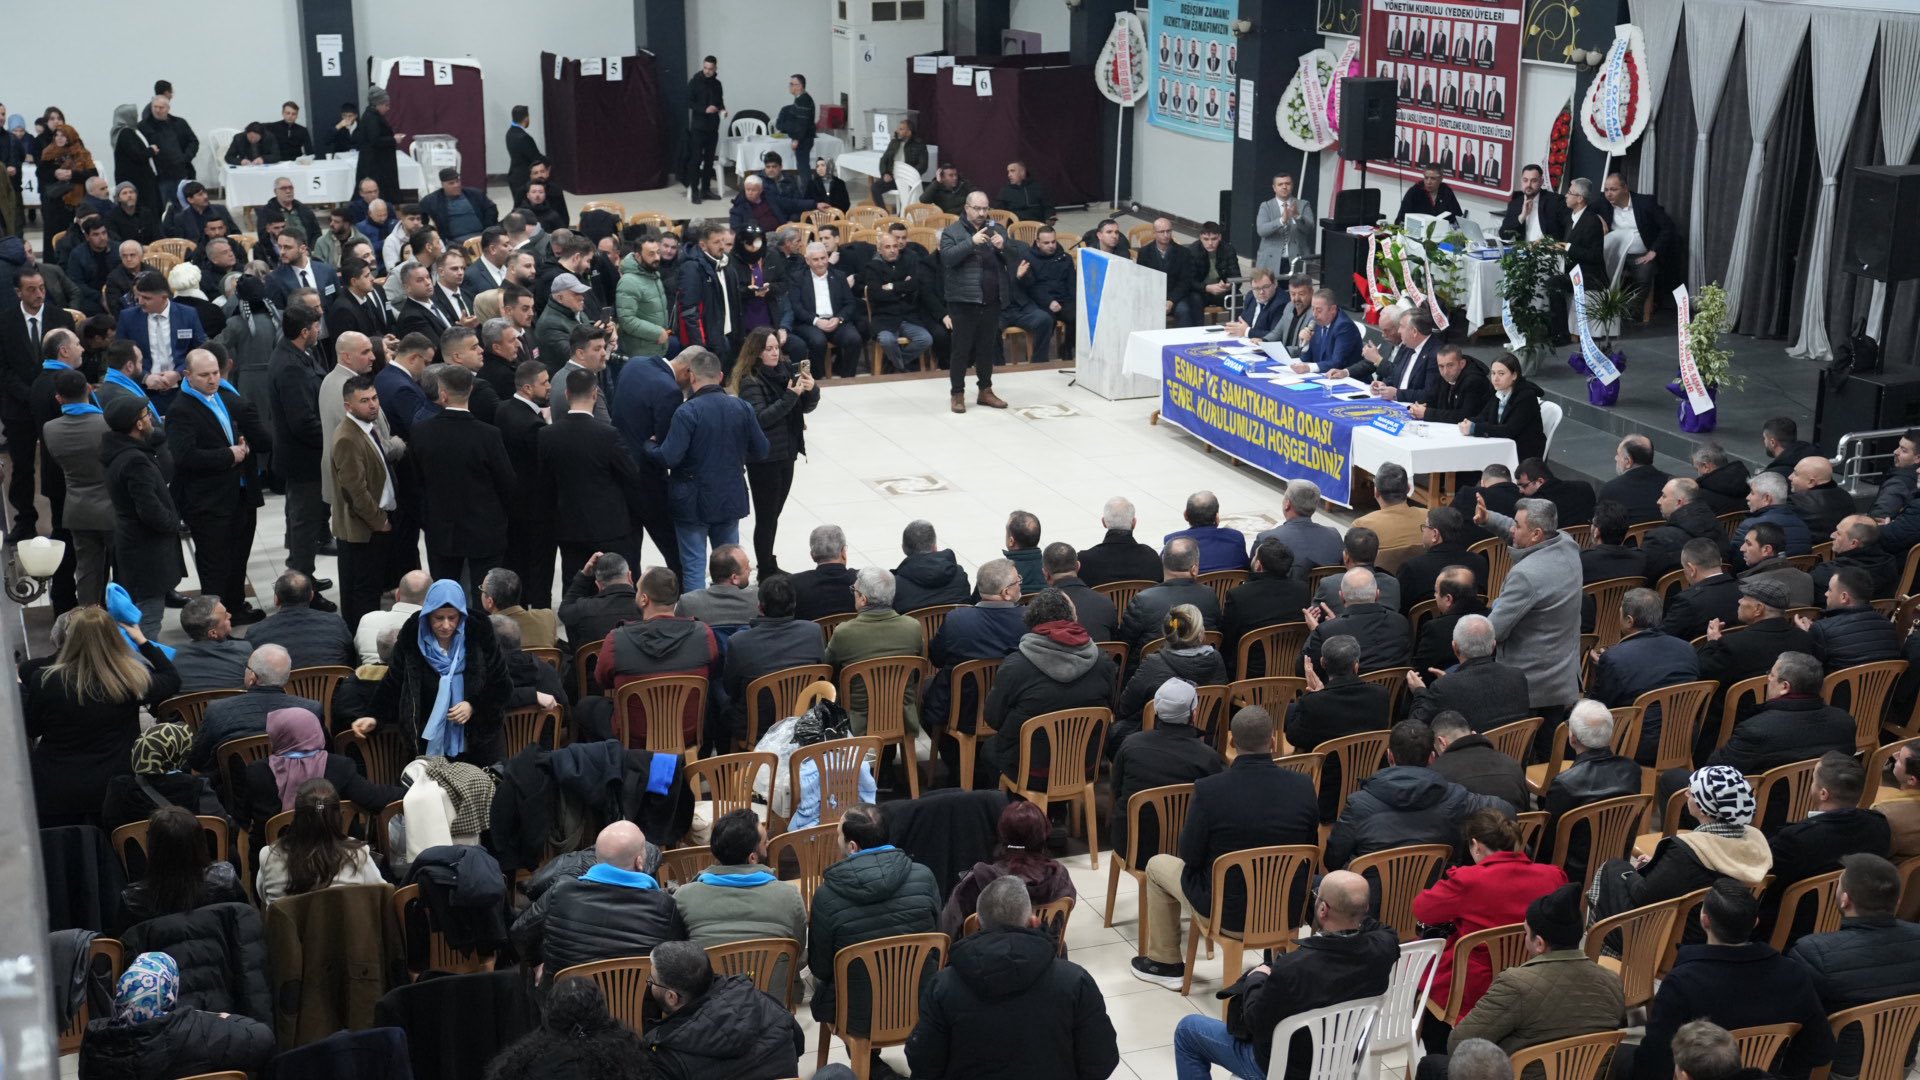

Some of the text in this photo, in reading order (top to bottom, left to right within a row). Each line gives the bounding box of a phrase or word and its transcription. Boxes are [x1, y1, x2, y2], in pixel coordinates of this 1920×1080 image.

[1385, 2, 1504, 21] YÖNETİM KURULU (YEDEK) ÜYELERİ
[864, 50, 872, 62] 6
[327, 58, 335, 70] 5
[610, 62, 618, 75] 5
[439, 66, 447, 78] 5
[981, 77, 988, 89] 6
[878, 121, 885, 133] 6
[25, 180, 34, 192] 4
[313, 176, 321, 190] 5
[1175, 355, 1206, 390] ESNAF
[1206, 370, 1219, 399] VE
[1221, 379, 1295, 432] SANATKARLAR
[1297, 411, 1334, 445] ODASI
[1167, 379, 1345, 481] GENEL KURULUMUZA HOŞGELDİNİZ
